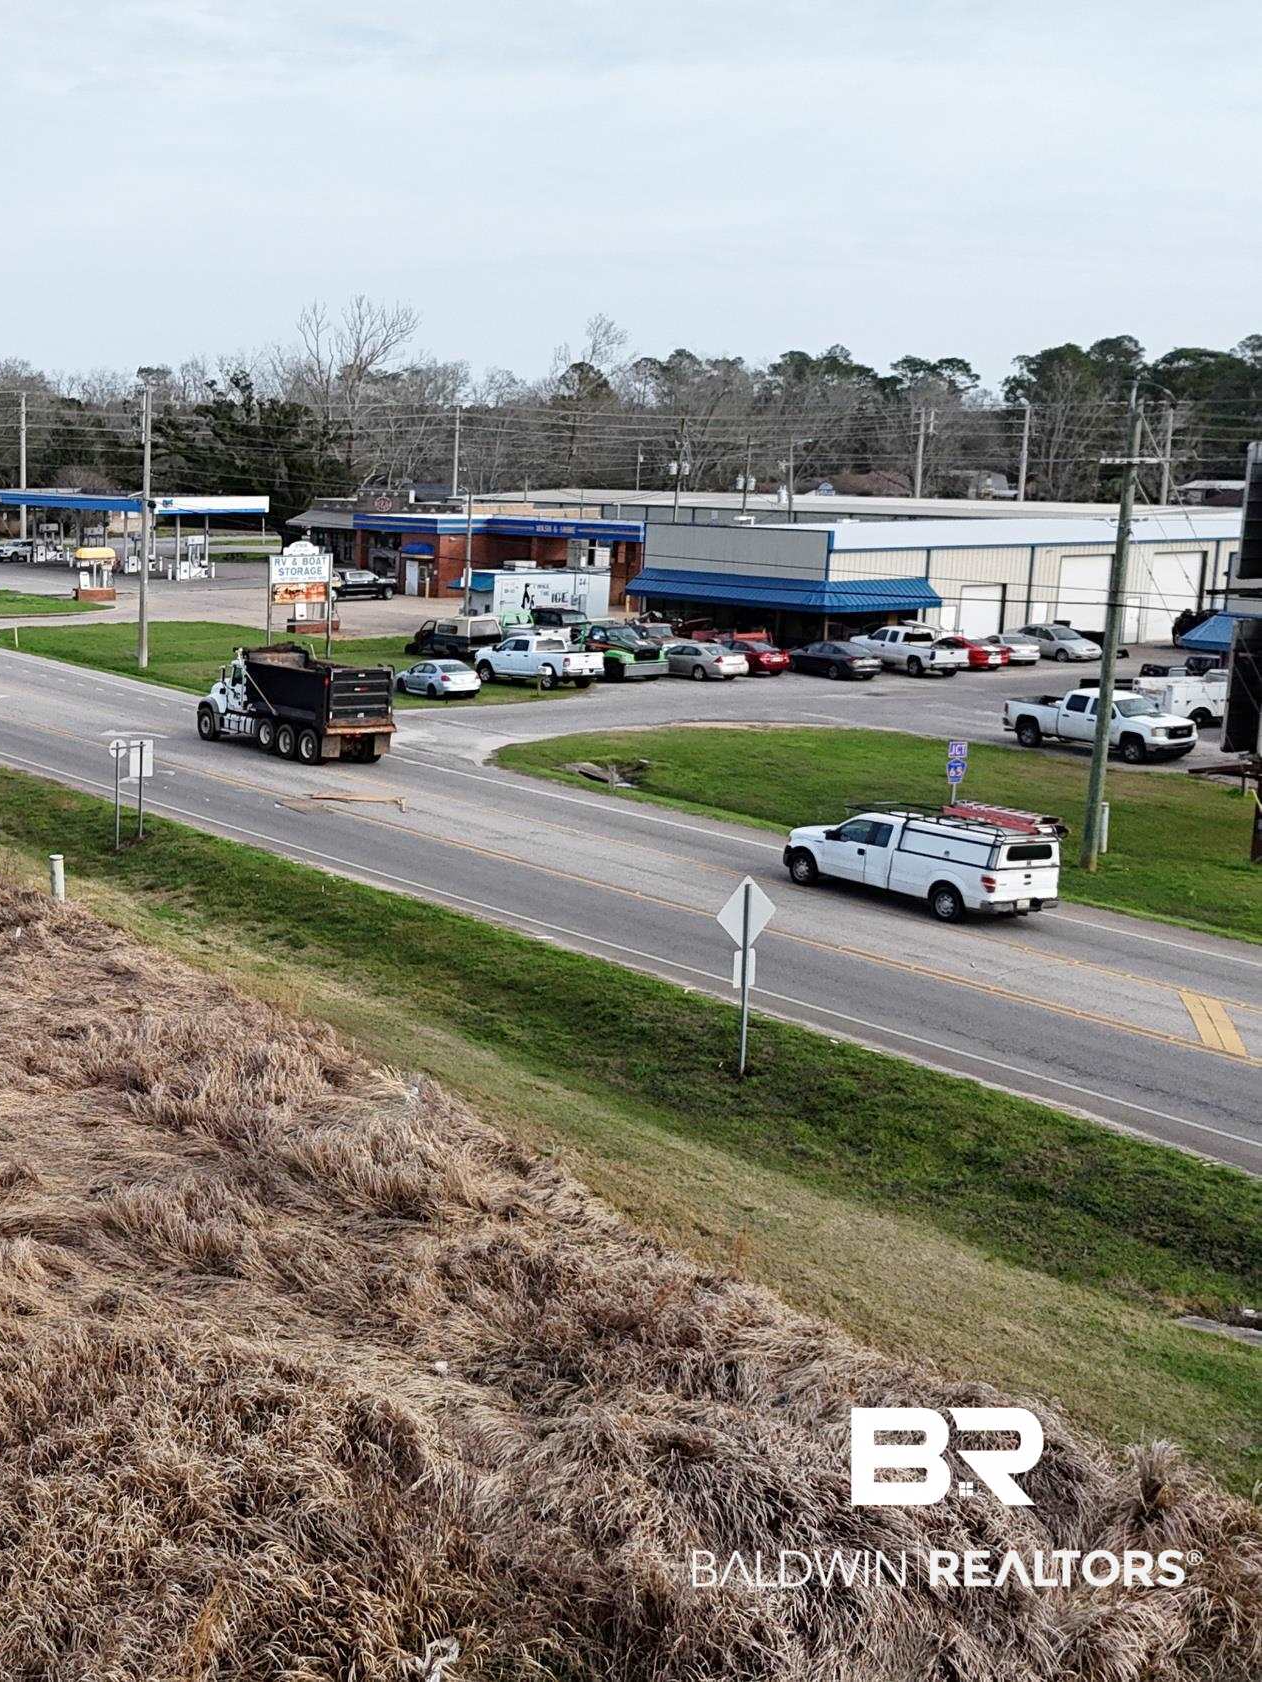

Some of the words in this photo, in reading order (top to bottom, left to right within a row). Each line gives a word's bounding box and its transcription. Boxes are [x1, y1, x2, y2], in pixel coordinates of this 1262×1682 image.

[275, 558, 287, 566] RV
[292, 558, 298, 566] &
[302, 557, 327, 566] BOAT
[278, 567, 323, 576] STORAGE
[551, 591, 569, 603] ICE
[949, 744, 966, 755] JCT
